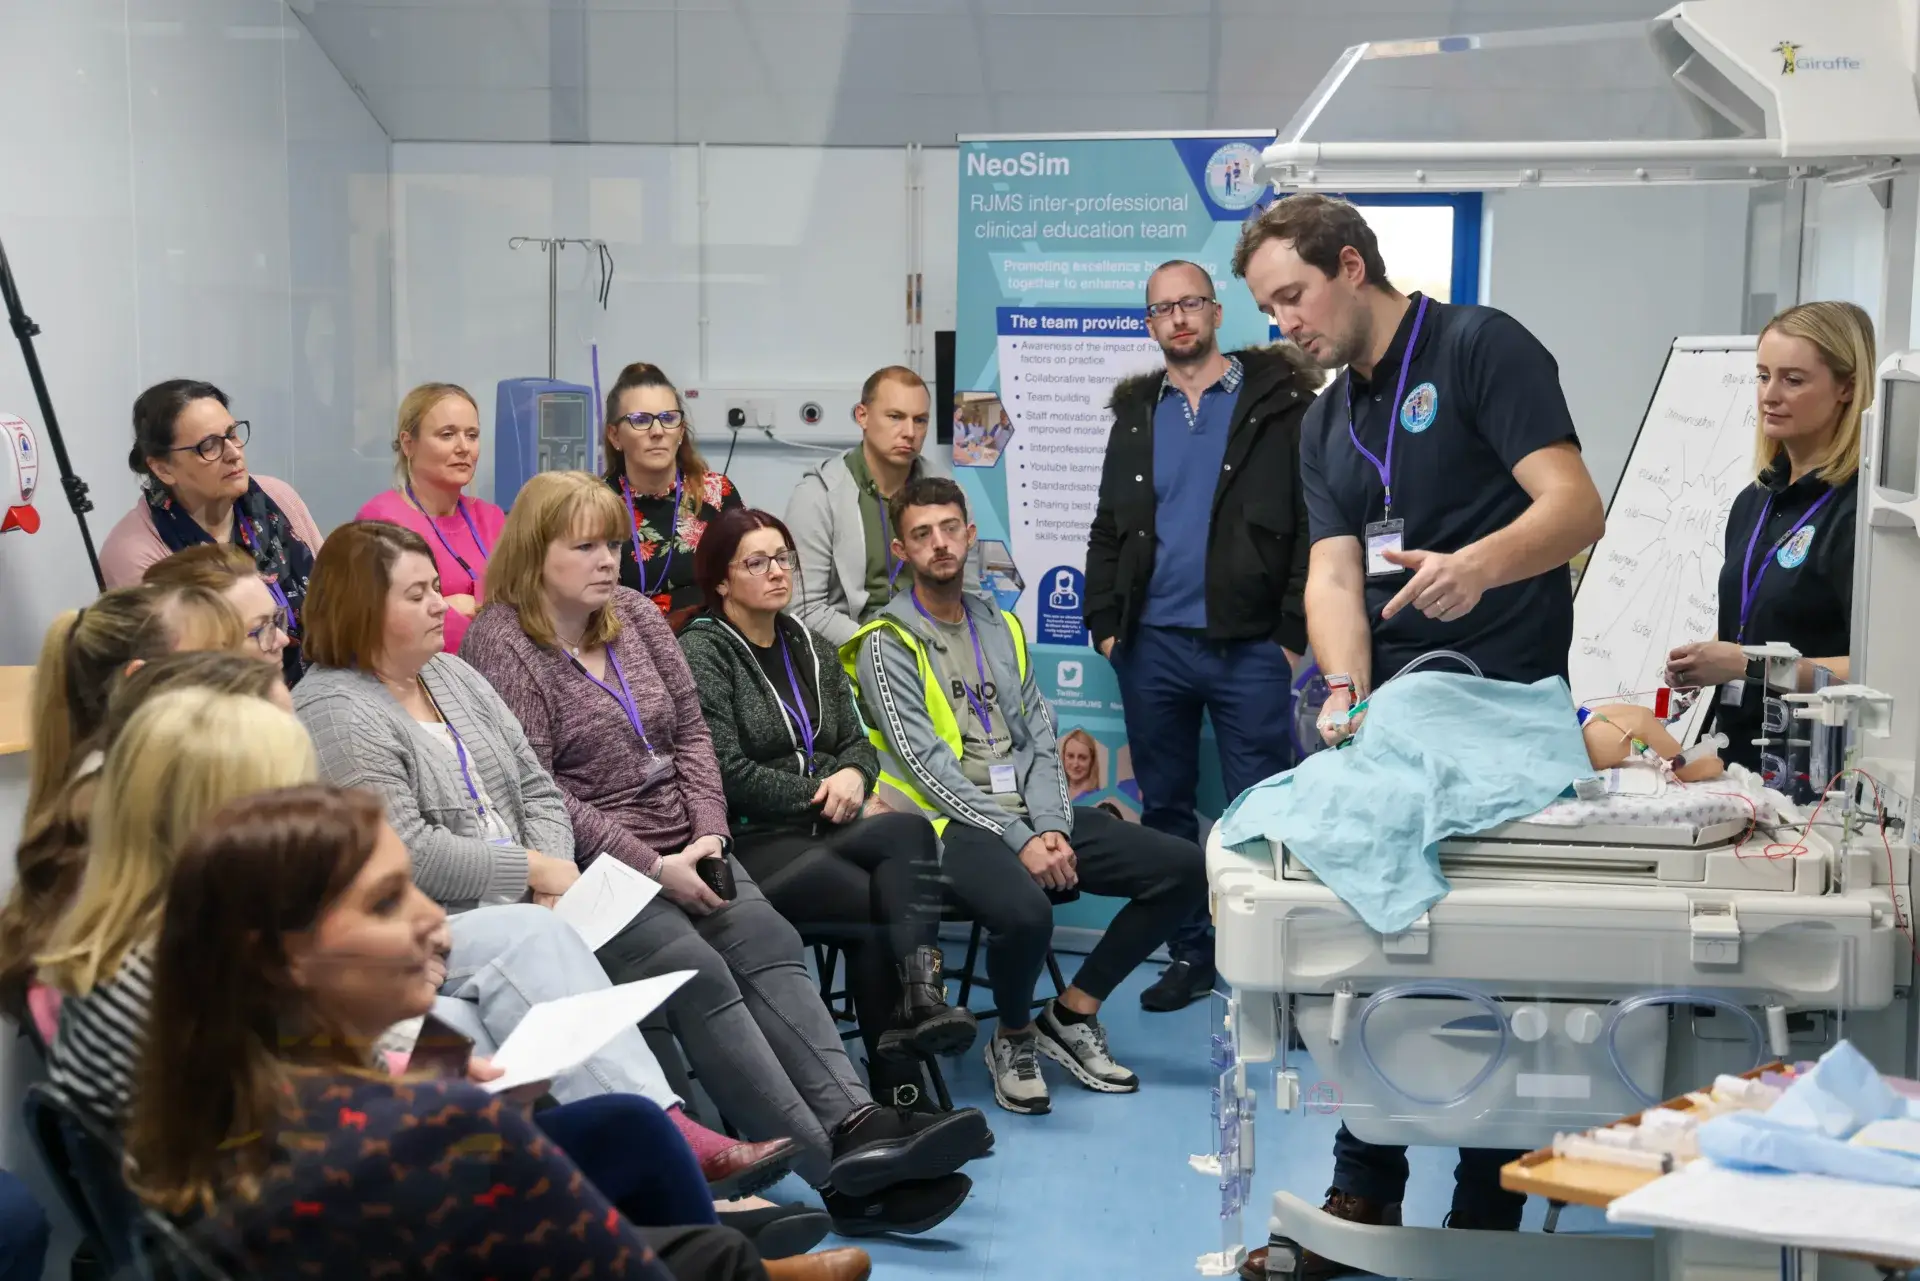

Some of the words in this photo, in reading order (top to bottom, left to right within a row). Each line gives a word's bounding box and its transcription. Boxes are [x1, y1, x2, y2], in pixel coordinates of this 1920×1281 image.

[1796, 56, 1861, 70] Giraffe
[967, 151, 1070, 177] NeoSim
[971, 193, 1023, 212] RJMS
[1028, 192, 1189, 215] inter-professional
[974, 220, 1037, 239] clinical
[1042, 220, 1134, 239] education
[1140, 222, 1188, 239] team
[1003, 259, 1070, 276] Promoting
[1073, 259, 1141, 273] excellence
[1007, 276, 1060, 292] together
[1063, 277, 1077, 290] to
[1080, 277, 1136, 291] enhance
[1010, 314, 1037, 329] The
[1041, 315, 1078, 329] team
[1082, 315, 1144, 332] provide:
[1021, 341, 1072, 351] Awareness
[1074, 342, 1084, 351] of
[1086, 342, 1100, 352] the
[1103, 342, 1134, 353] impact
[1137, 343, 1146, 352] of
[1149, 343, 1162, 352] hu
[1020, 354, 1051, 364] factors
[1054, 356, 1066, 364] on
[1069, 355, 1105, 366] practice
[1025, 373, 1085, 384] Collaborative
[1088, 374, 1121, 384] learnin
[1027, 392, 1052, 402] Team
[1054, 393, 1091, 405] building
[1026, 410, 1048, 420] Staff
[1049, 411, 1097, 422] motivation
[1028, 424, 1071, 436] improved
[1074, 425, 1105, 436] morale
[1029, 443, 1107, 454] Interprofessional
[1030, 462, 1067, 472] Youtube
[1034, 499, 1070, 512] Sharing
[1072, 501, 1091, 511] best
[1036, 518, 1090, 531] Interprofess
[1035, 532, 1058, 541] skills
